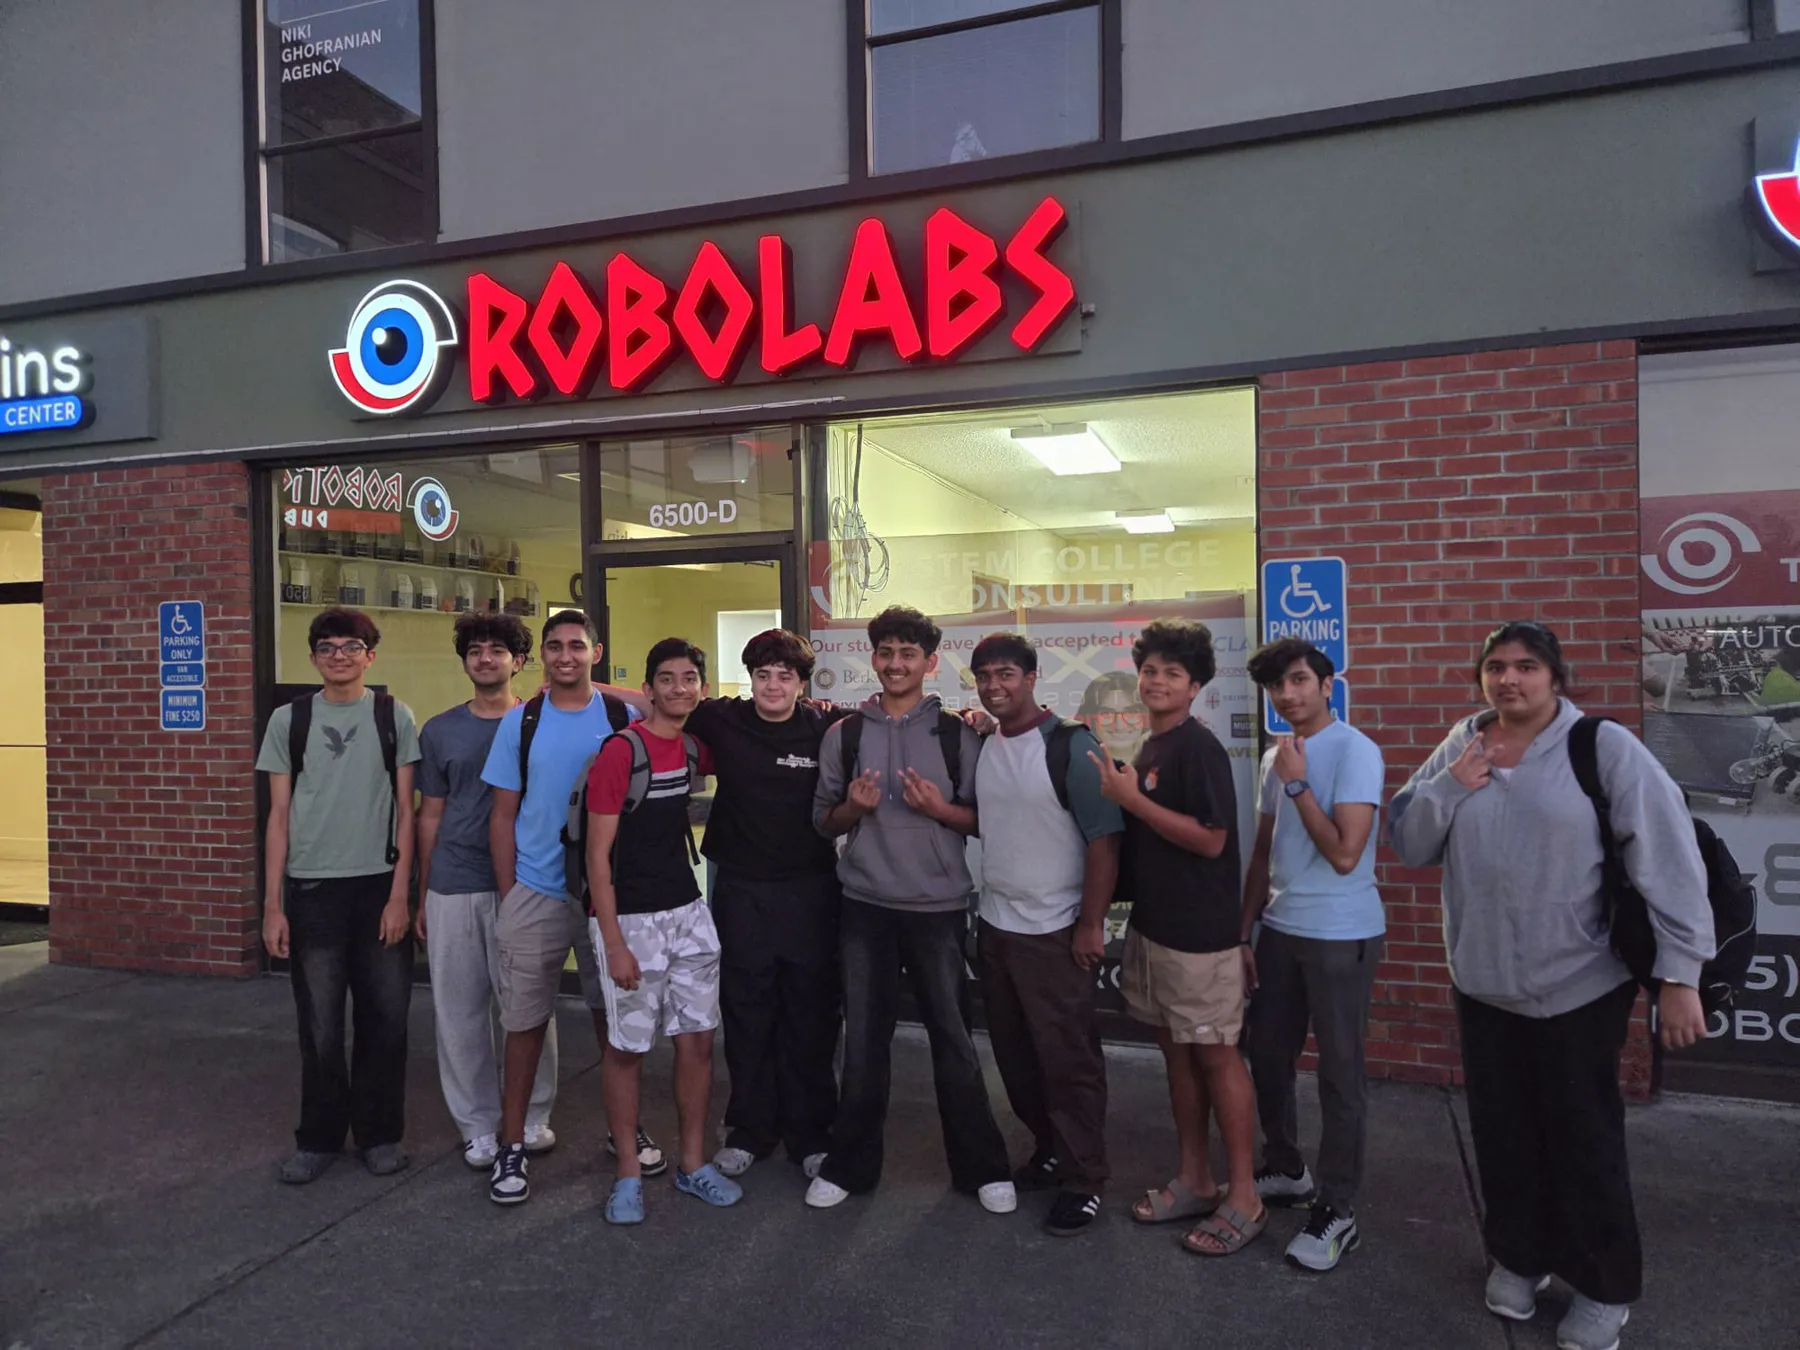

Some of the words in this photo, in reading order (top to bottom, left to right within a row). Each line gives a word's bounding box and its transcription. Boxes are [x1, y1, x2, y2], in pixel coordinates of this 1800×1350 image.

[281, 24, 311, 43] NIKI
[281, 29, 381, 63] GHOFRANIAN
[281, 57, 342, 83] AGENCY
[467, 196, 1074, 400] ROBOLABS
[5, 401, 76, 426] CENTER
[650, 499, 737, 527] 6500-D
[1031, 539, 1221, 574] COLLEGE
[1269, 618, 1340, 641] PARKING
[163, 635, 200, 646] PARKING
[811, 639, 842, 652] Our
[936, 641, 973, 651] ave
[1035, 631, 1123, 650] accepted
[1214, 636, 1252, 653] CLA
[171, 649, 192, 660] ONLY
[167, 674, 198, 682] ACCESSIBLE
[168, 695, 198, 706] MINIMUM
[165, 710, 180, 721] FINE
[181, 709, 200, 723] $250
